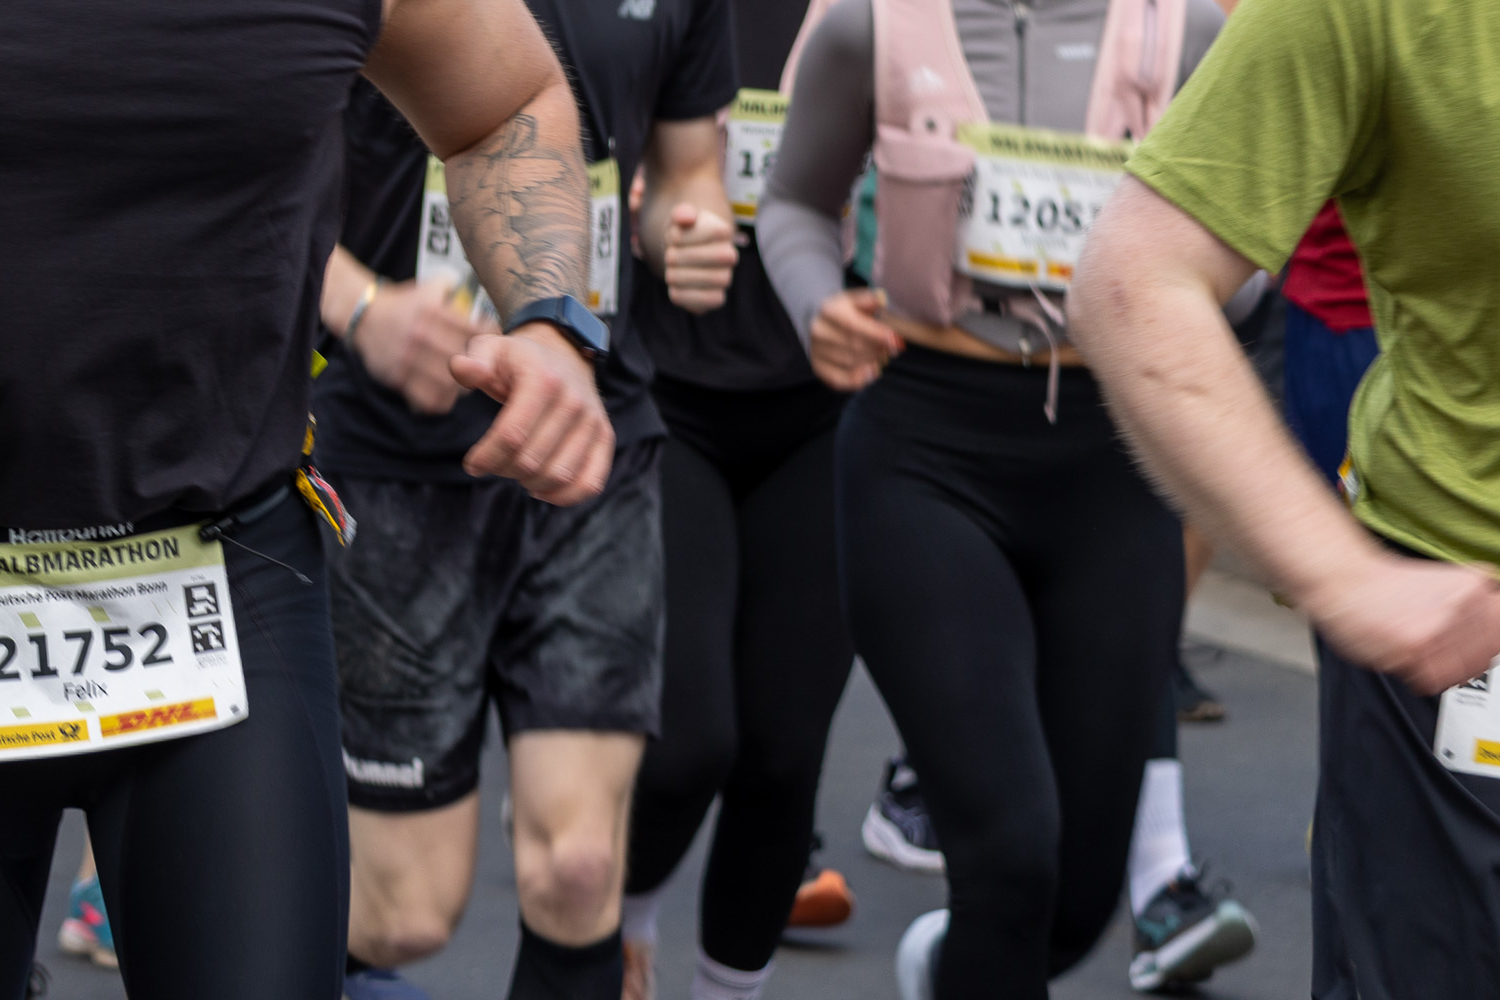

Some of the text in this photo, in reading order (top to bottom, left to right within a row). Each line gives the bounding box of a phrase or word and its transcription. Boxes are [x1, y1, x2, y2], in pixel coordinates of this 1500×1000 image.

[74, 585, 136, 602] Marathon
[63, 681, 109, 702] Felix
[31, 730, 57, 743] Post
